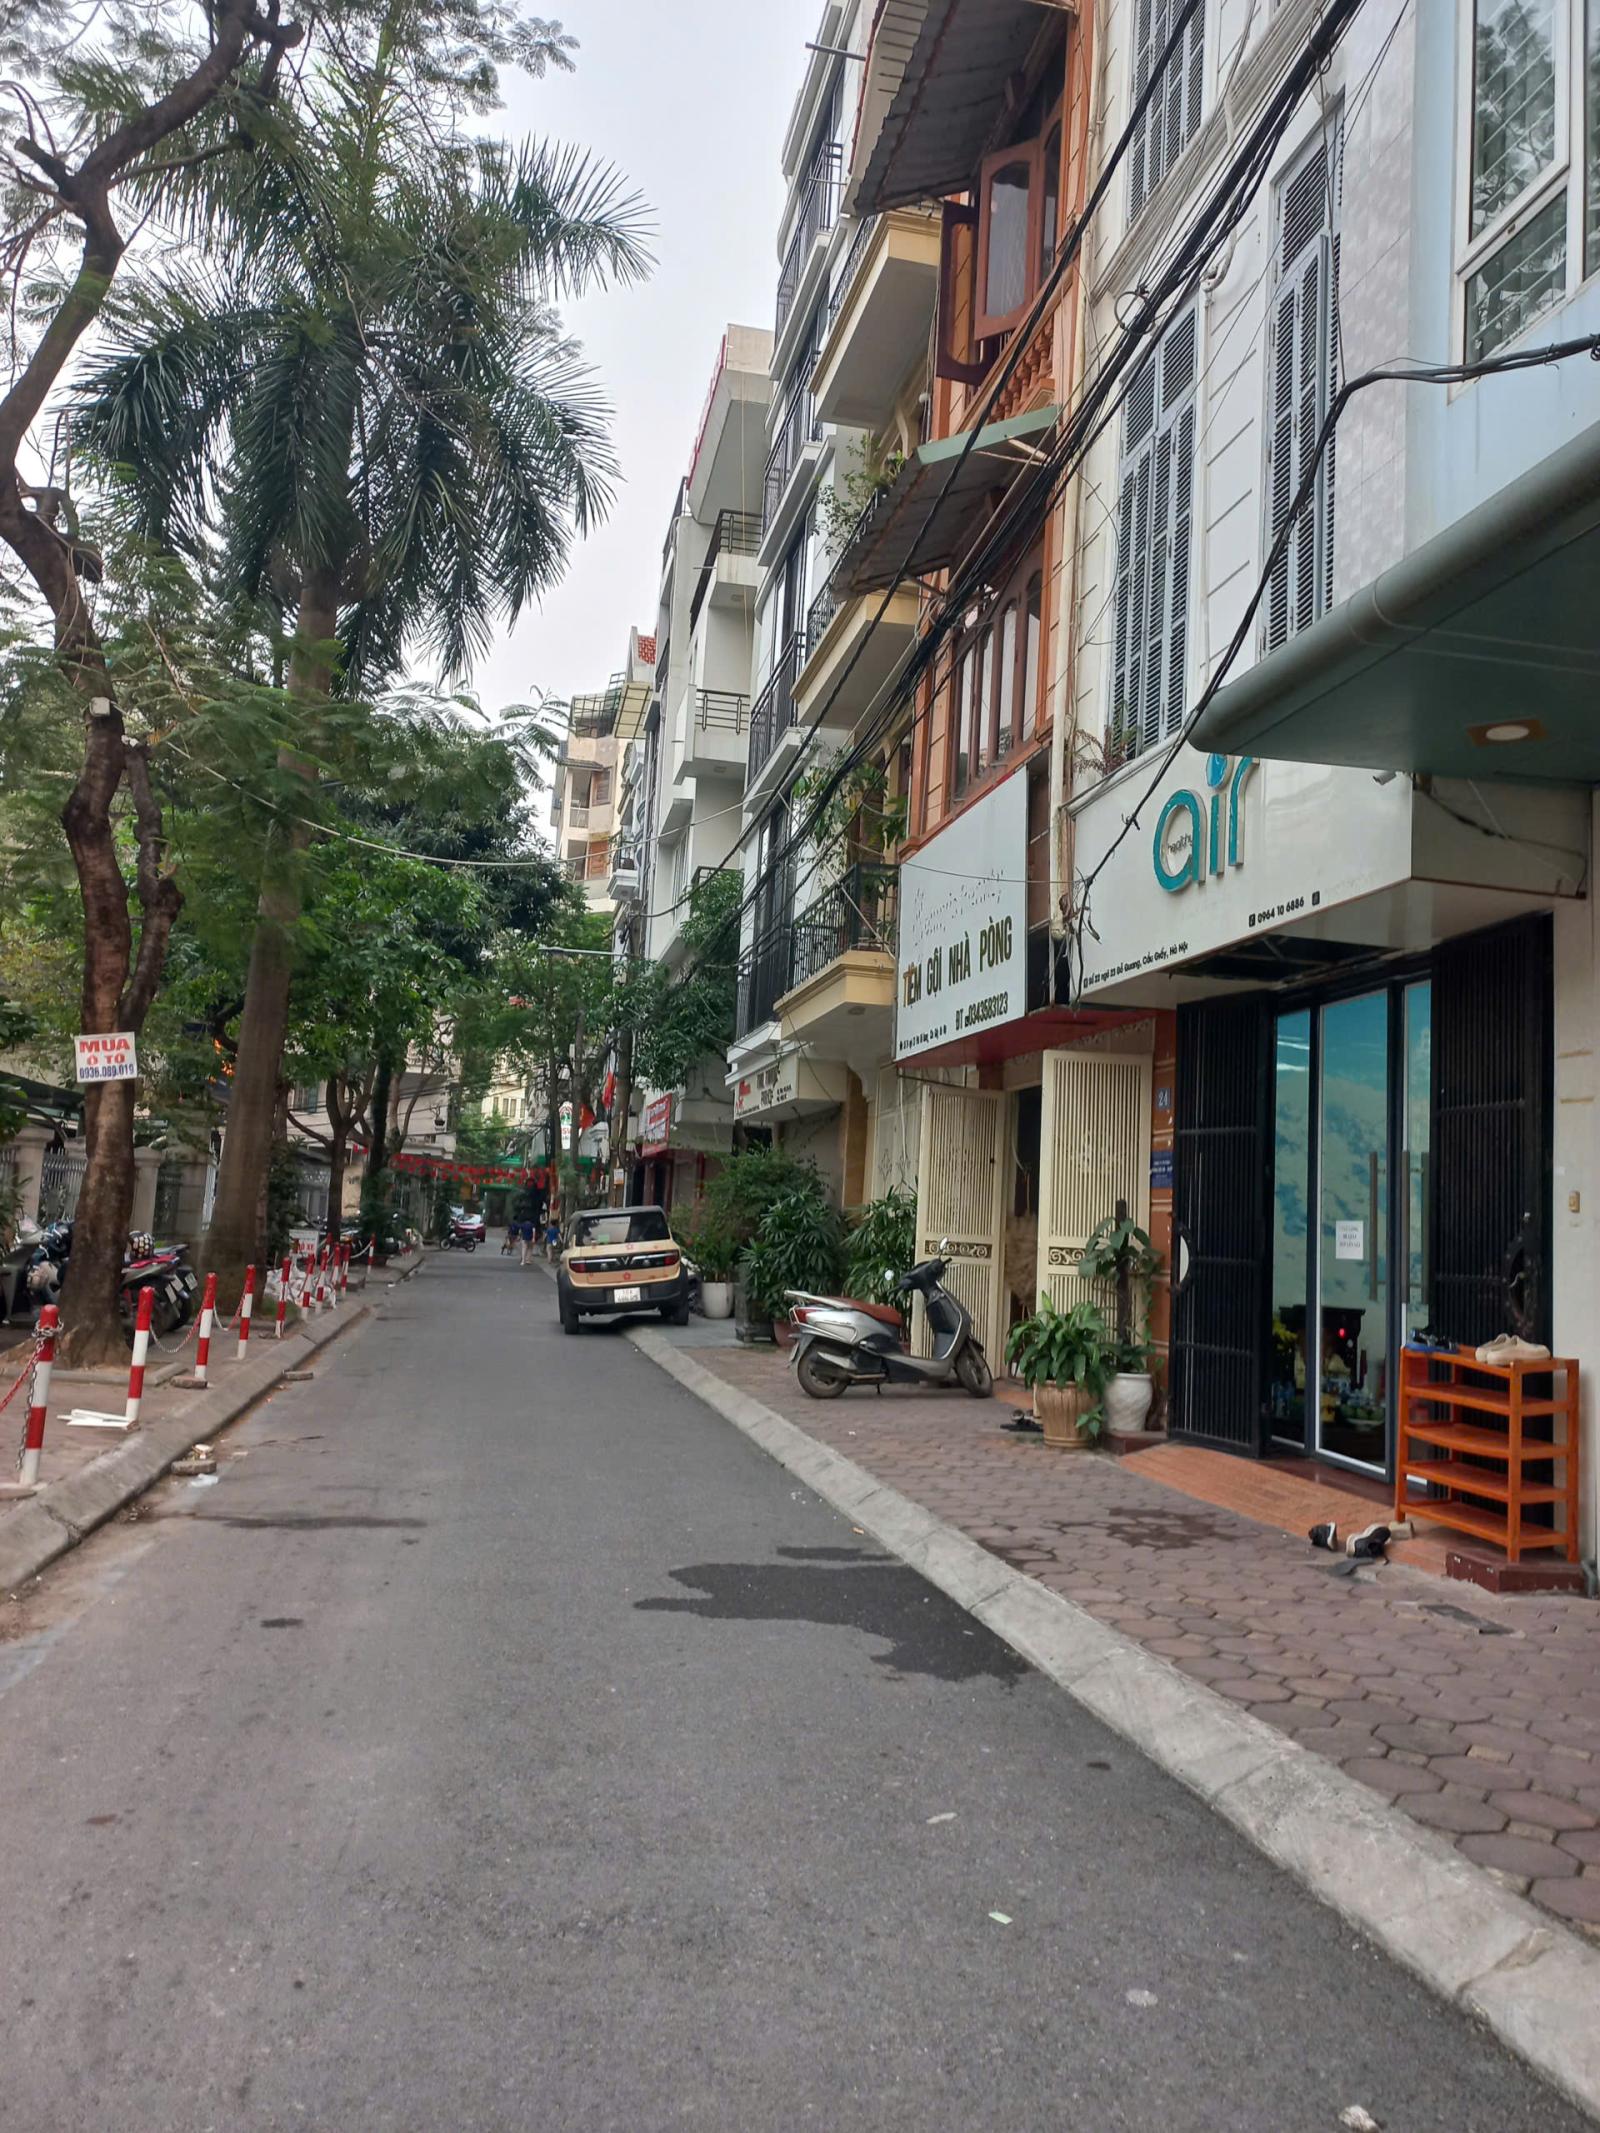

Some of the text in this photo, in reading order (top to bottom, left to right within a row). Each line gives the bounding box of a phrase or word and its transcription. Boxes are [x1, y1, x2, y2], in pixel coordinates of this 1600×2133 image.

[1257, 896, 1305, 924] 0964 10 6886
[948, 930, 971, 986] NHÀ
[979, 915, 1012, 972] PÒNG
[80, 1039, 130, 1053] MUA
[1158, 1089, 1168, 1107] 24
